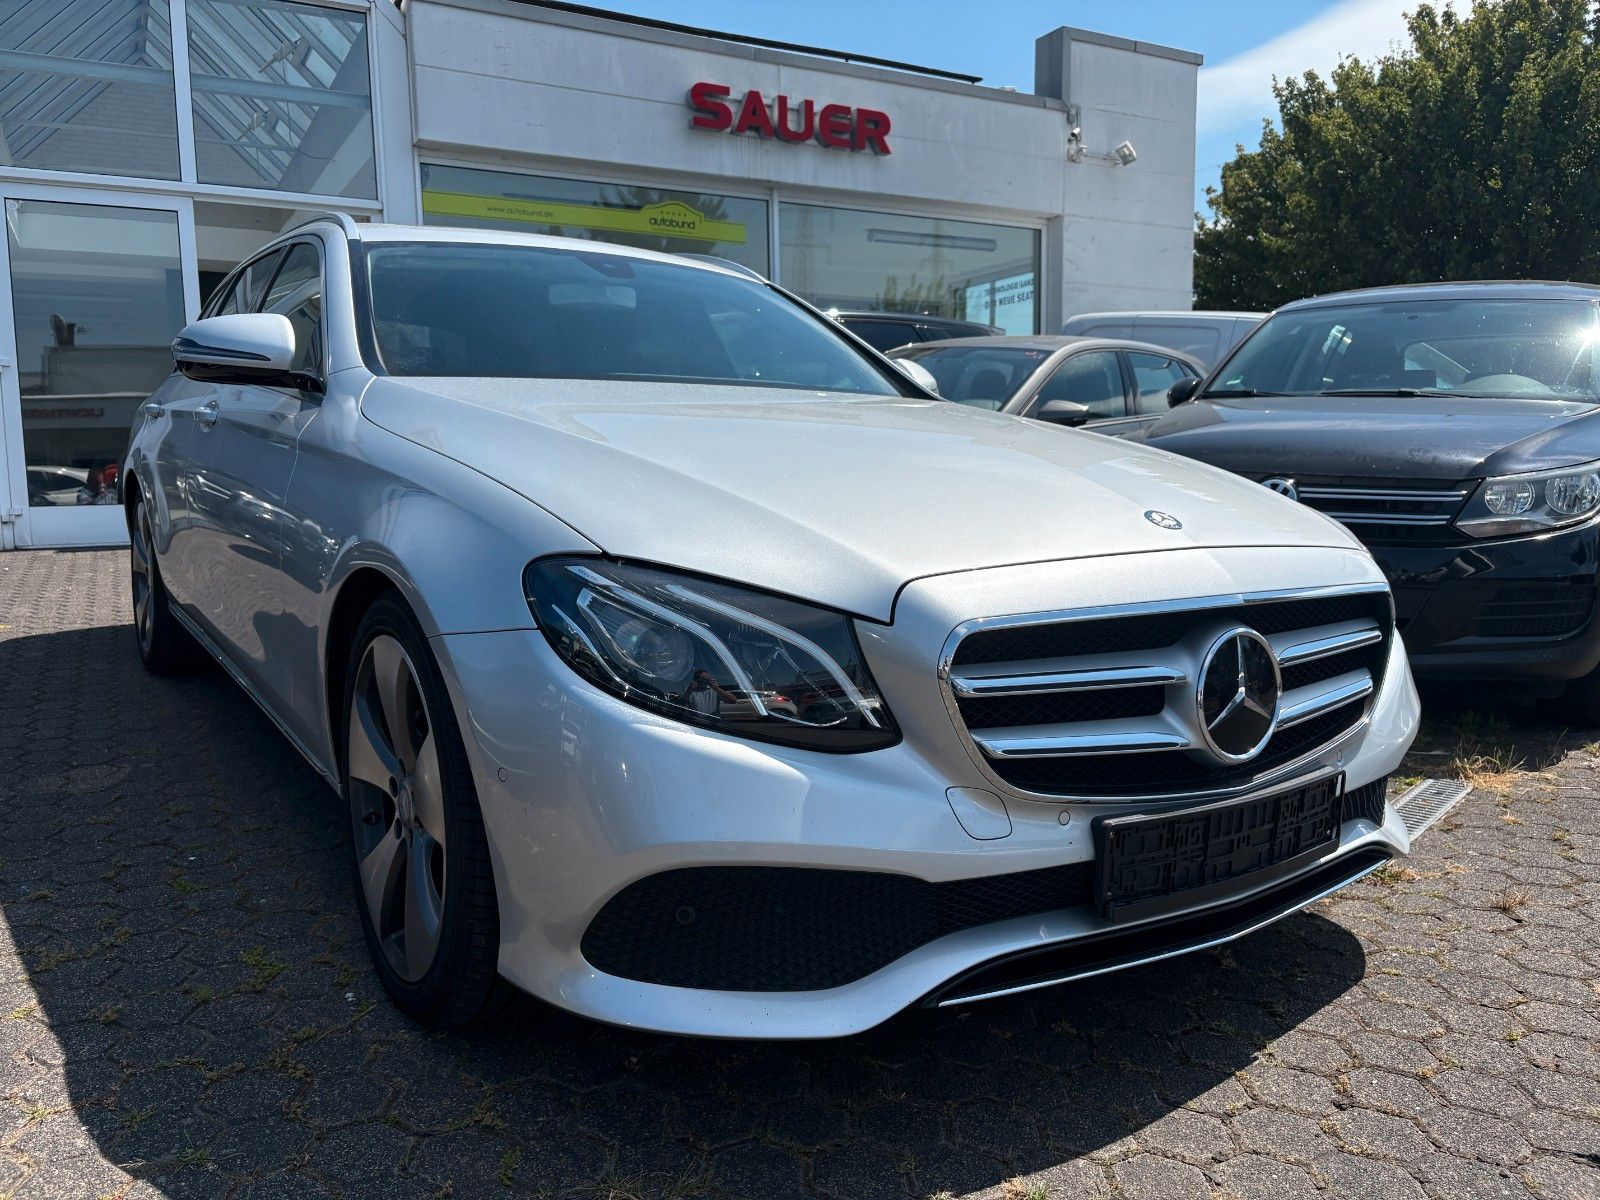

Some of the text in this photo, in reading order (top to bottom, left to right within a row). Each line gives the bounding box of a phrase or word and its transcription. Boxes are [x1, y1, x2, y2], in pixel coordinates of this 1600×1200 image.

[688, 82, 892, 155] SAUER
[486, 205, 554, 218] www.autobund.de
[648, 217, 696, 230] autobund
